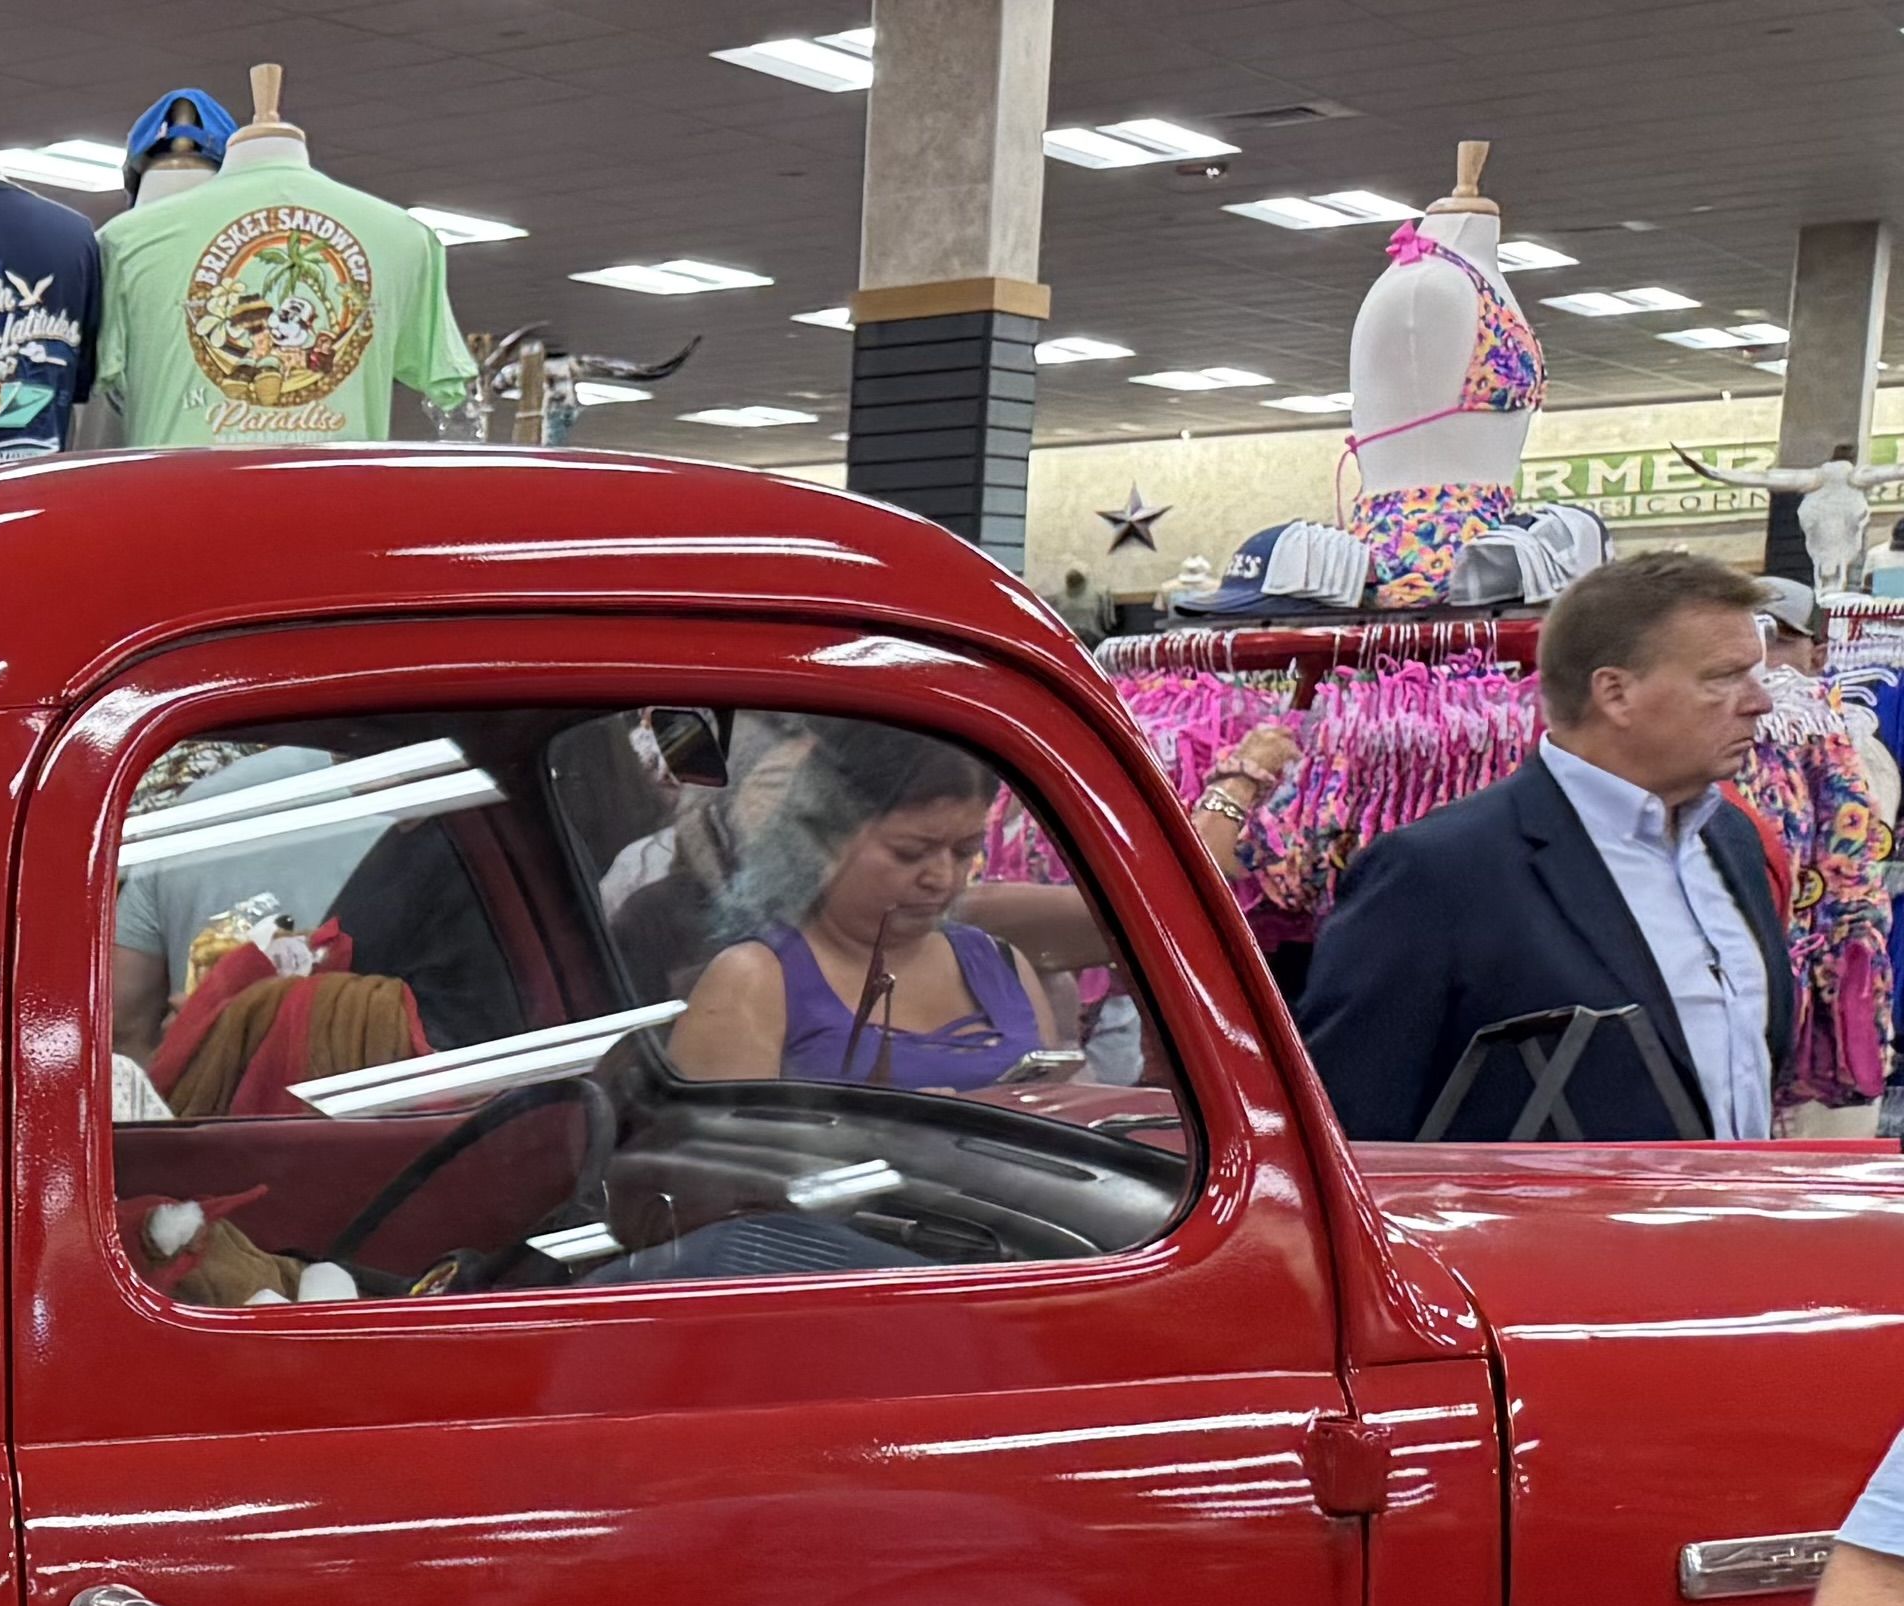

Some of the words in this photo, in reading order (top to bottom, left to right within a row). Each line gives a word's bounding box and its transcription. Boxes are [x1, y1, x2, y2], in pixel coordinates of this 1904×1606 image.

[194, 211, 271, 286] BRISKET
[277, 207, 368, 283] SANDWICH
[206, 400, 346, 434] Paradise
